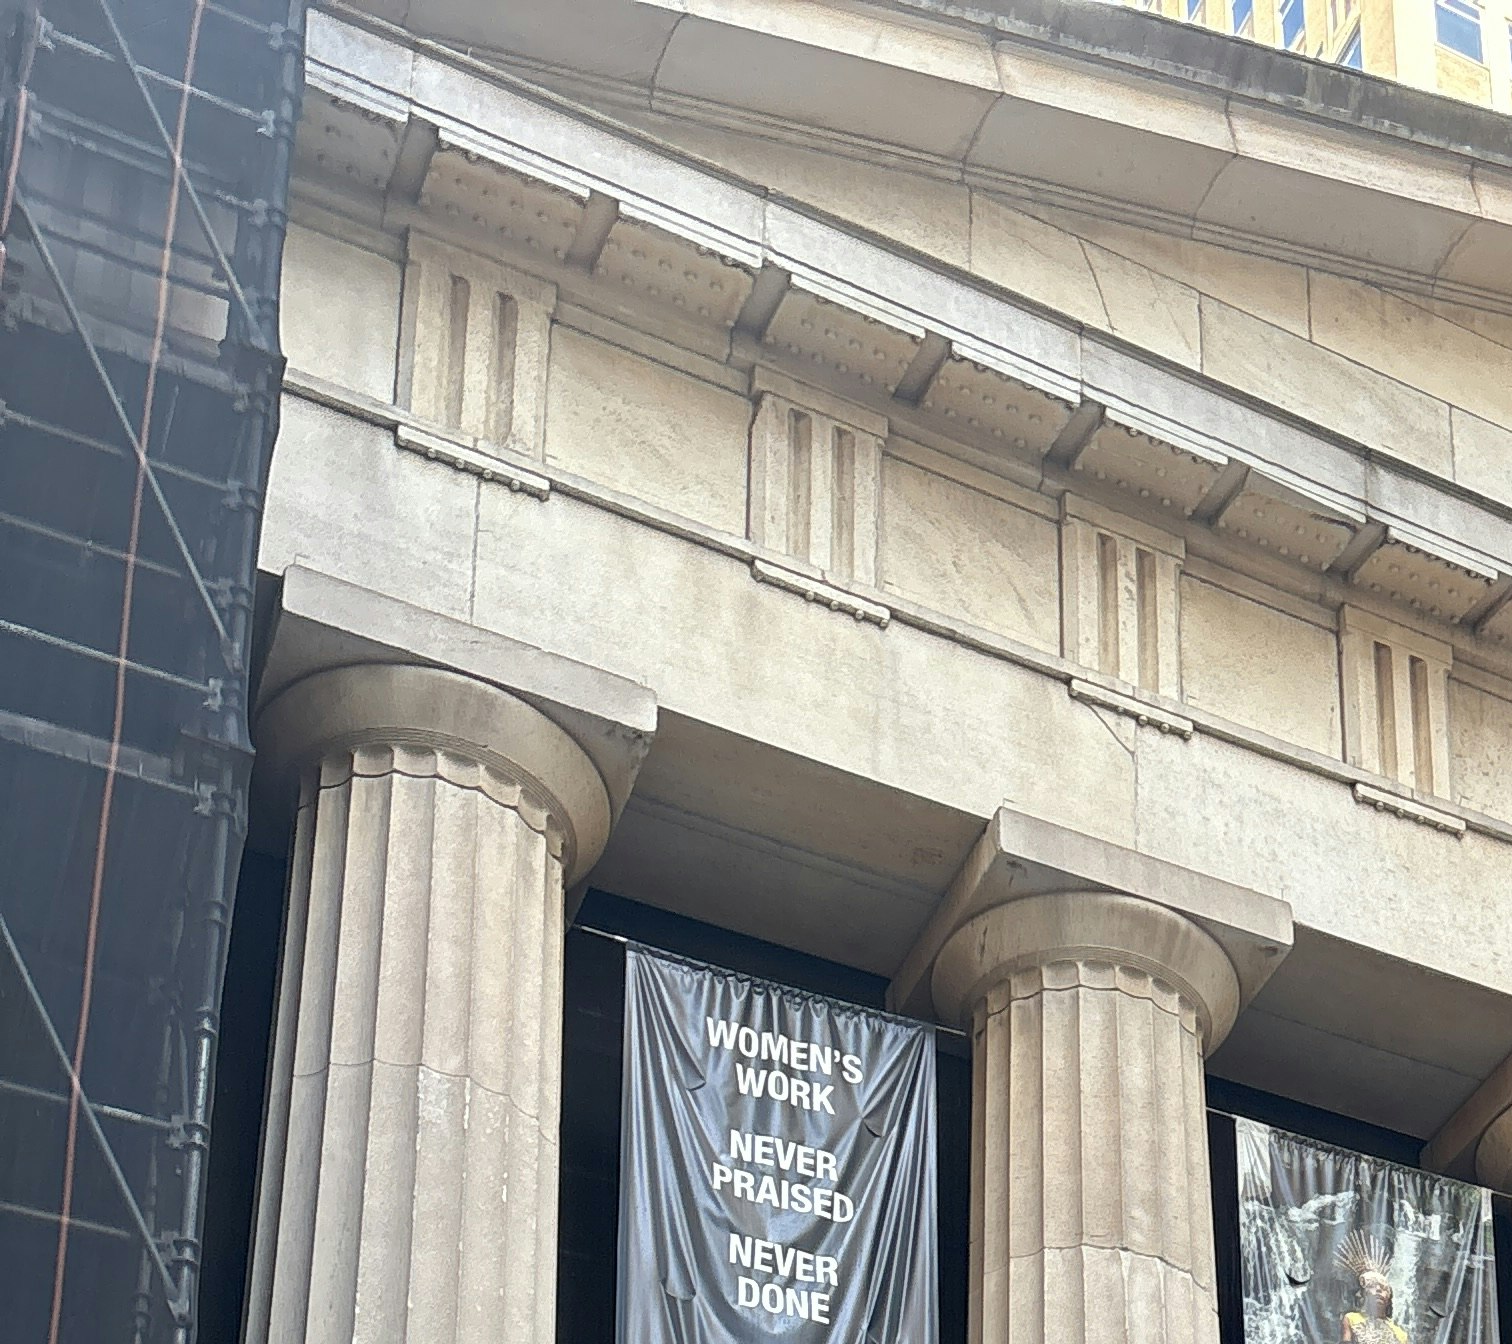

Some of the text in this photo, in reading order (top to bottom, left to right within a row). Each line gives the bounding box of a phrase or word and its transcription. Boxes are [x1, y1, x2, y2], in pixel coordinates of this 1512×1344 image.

[706, 1017, 864, 1084] WOMEN'S
[735, 1062, 836, 1115] WORK
[729, 1129, 839, 1182] NEVER
[712, 1162, 855, 1223] PRAISED
[729, 1233, 839, 1287] NEVER
[737, 1276, 831, 1325] DONE
